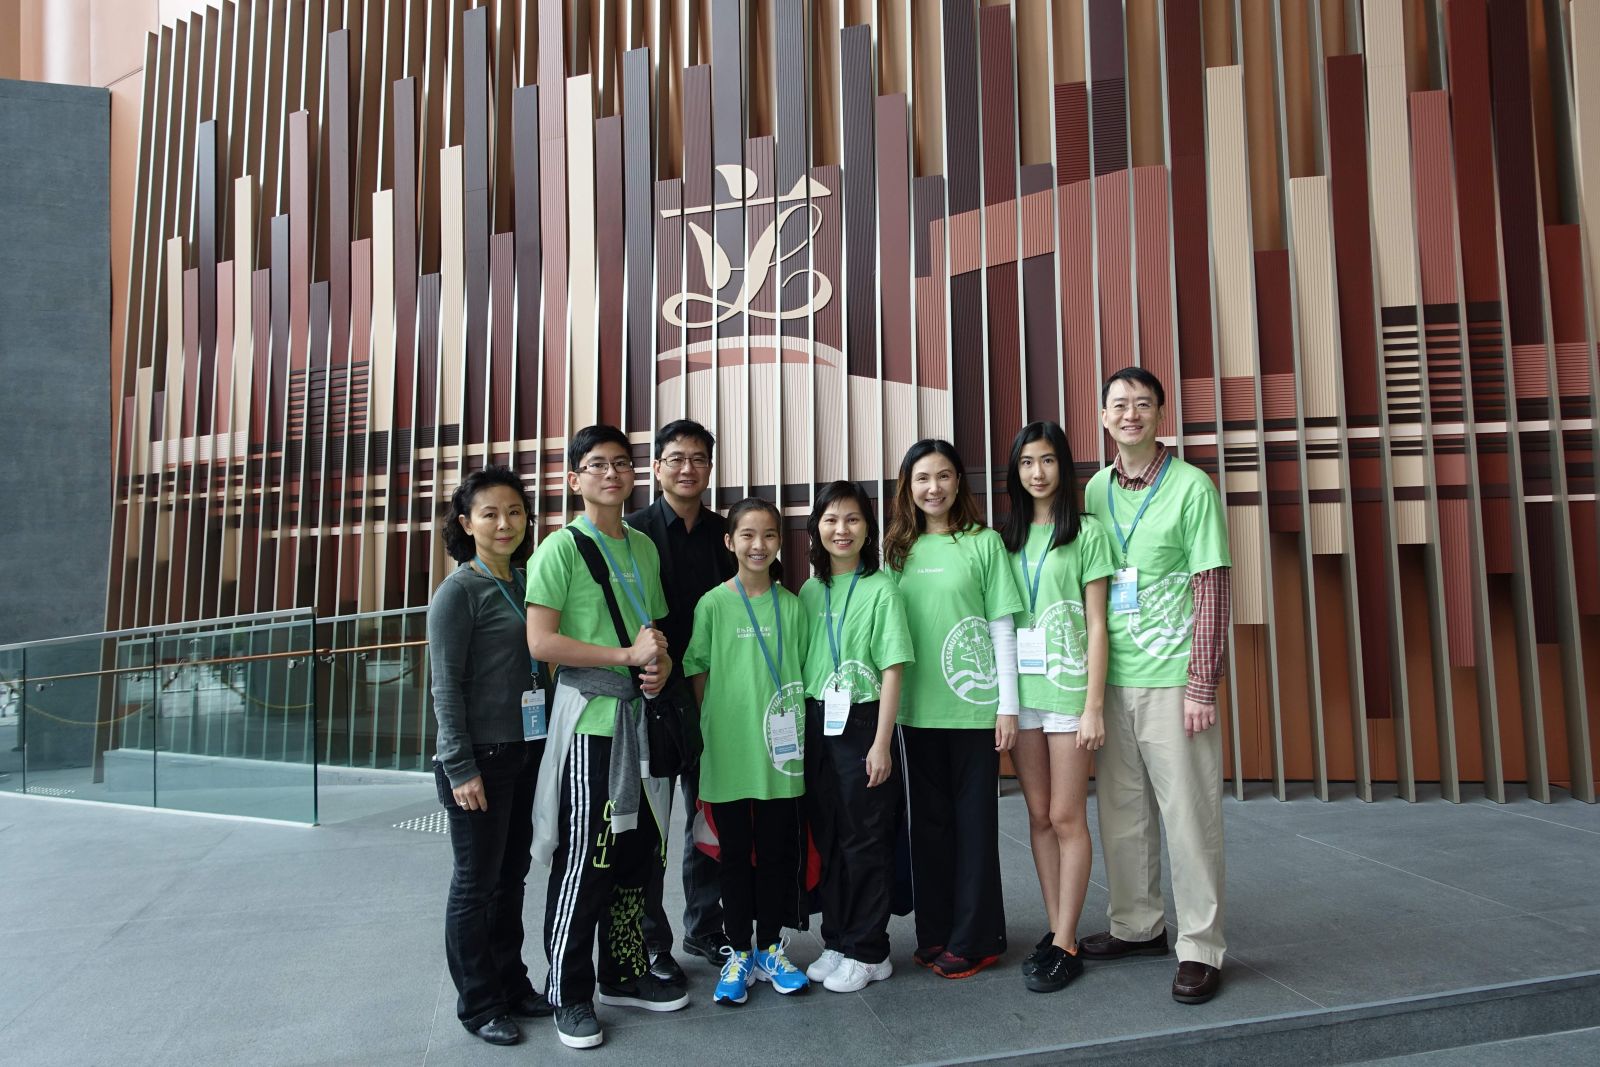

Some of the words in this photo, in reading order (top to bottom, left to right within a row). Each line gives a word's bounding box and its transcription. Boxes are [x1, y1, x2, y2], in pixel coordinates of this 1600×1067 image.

[1120, 592, 1128, 603] F
[1070, 605, 1084, 616] SPA
[944, 623, 968, 673] MASSMUTUAL
[531, 715, 538, 728] F
